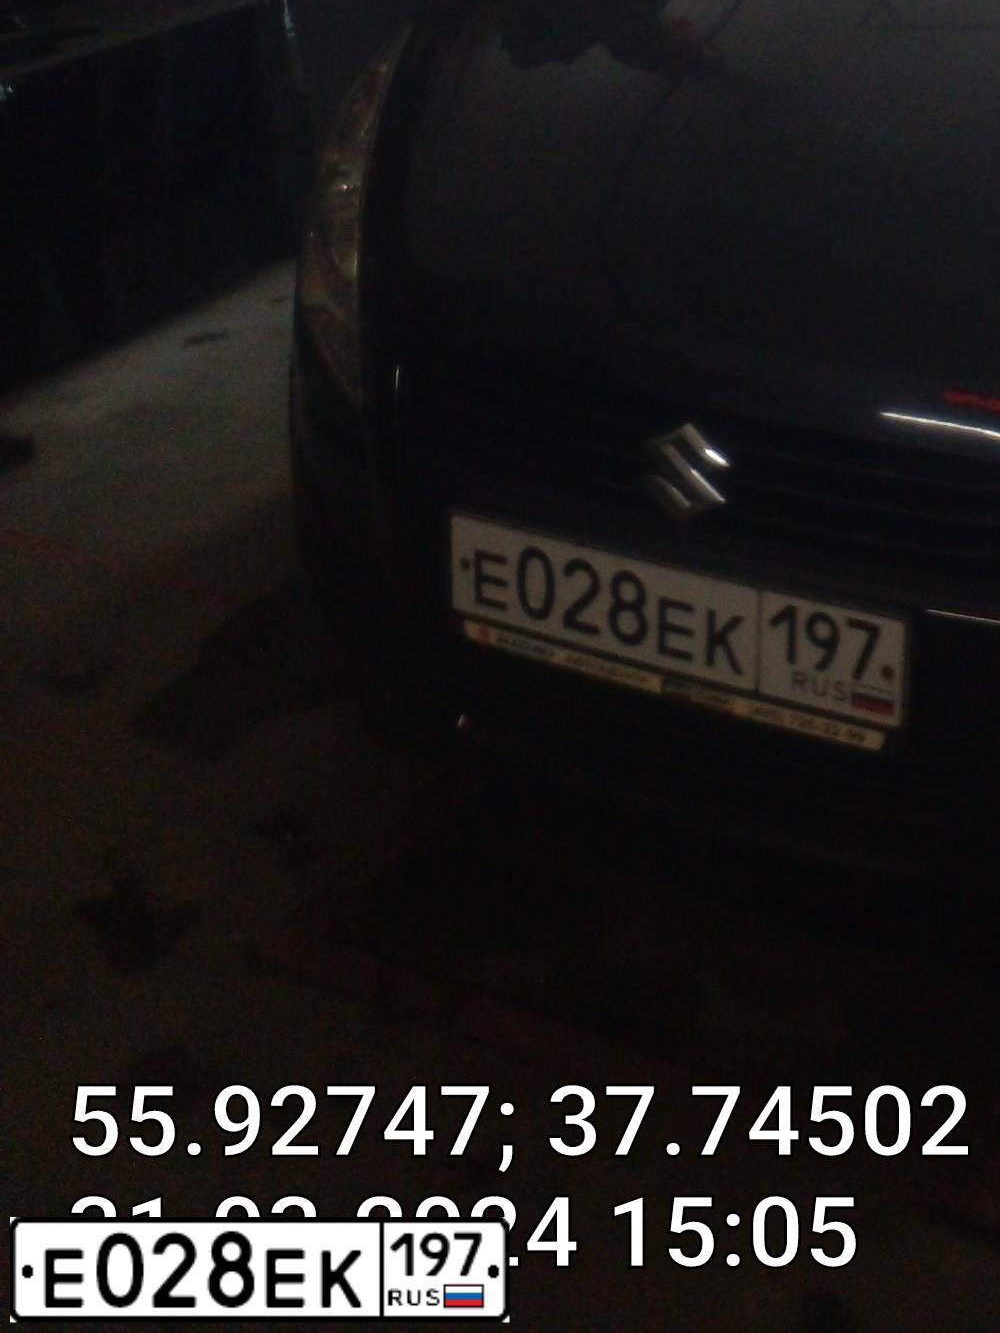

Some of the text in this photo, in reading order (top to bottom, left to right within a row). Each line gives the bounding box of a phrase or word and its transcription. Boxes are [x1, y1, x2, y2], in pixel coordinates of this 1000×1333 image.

[472, 545, 745, 677] E028EK
[769, 603, 881, 681] 197
[790, 669, 850, 702] RUS
